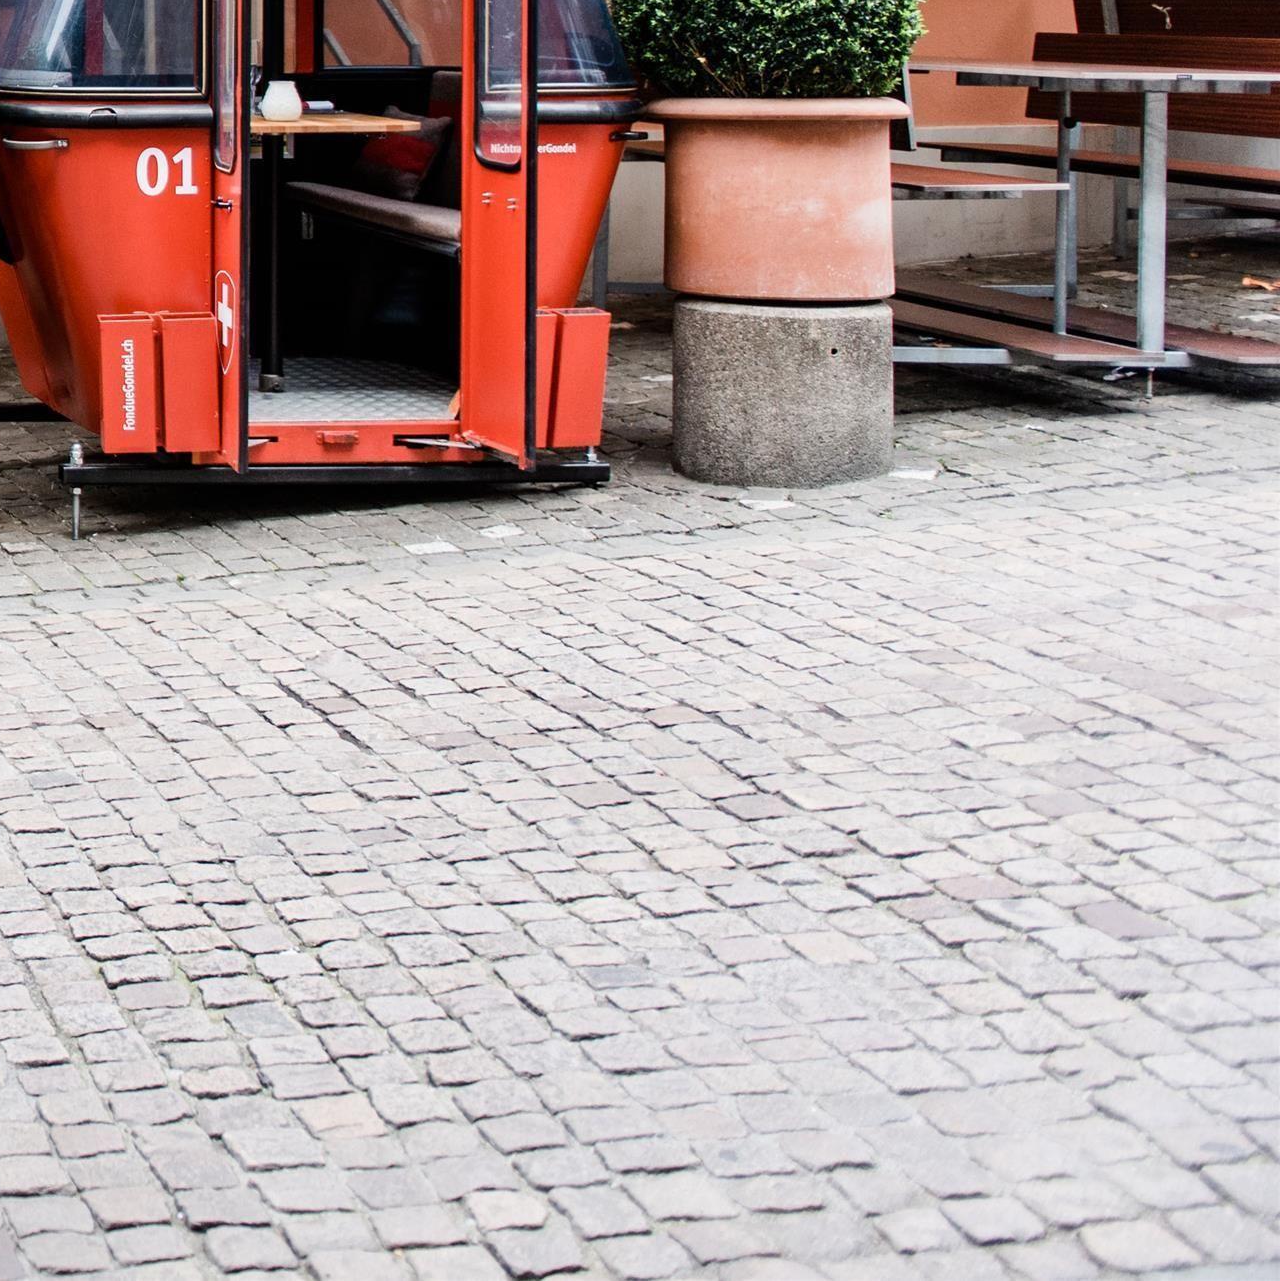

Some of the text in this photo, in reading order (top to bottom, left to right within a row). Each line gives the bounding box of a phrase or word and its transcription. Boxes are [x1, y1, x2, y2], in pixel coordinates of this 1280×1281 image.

[136, 147, 198, 196] 01
[490, 143, 576, 154] NichtraerGondel
[121, 339, 135, 431] FondueGondel.ch
